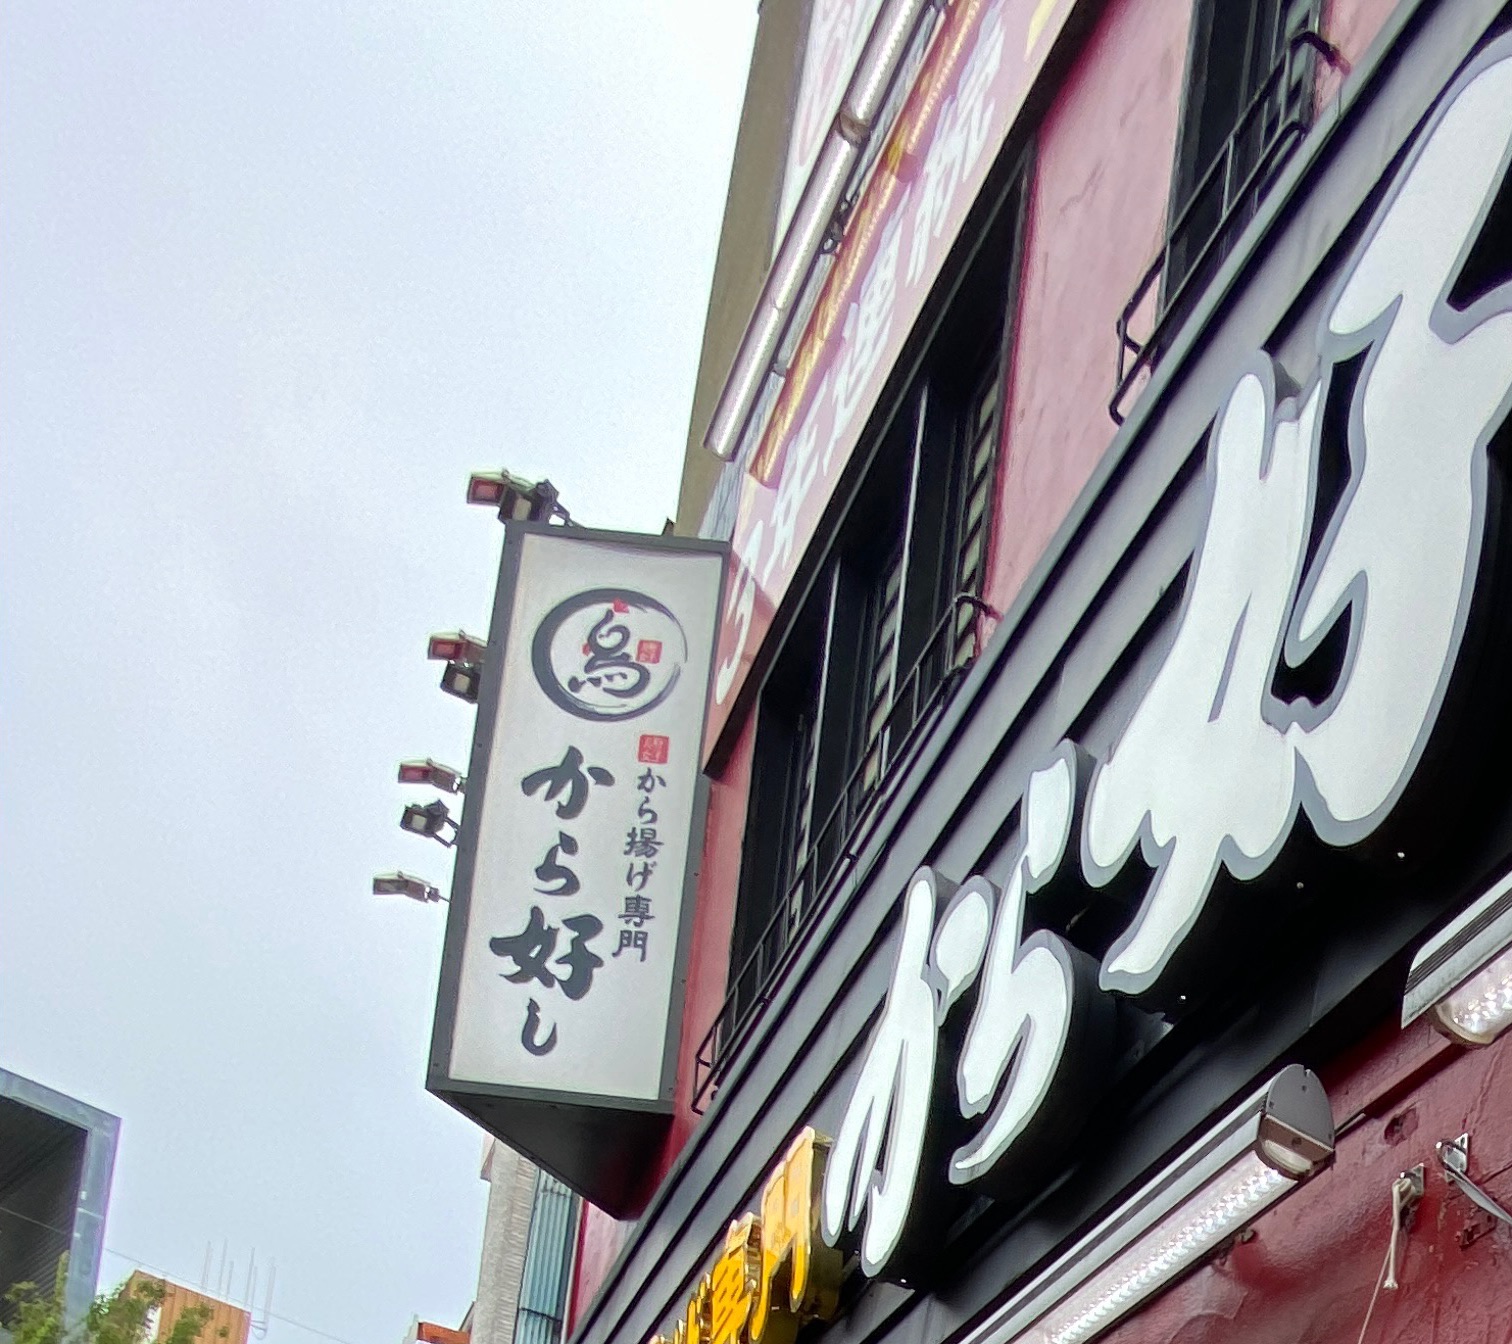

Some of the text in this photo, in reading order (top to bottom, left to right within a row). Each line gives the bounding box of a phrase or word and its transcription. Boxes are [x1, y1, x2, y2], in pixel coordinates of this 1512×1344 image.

[489, 744, 616, 1056] から好し
[612, 766, 668, 963] から揚げ専門
